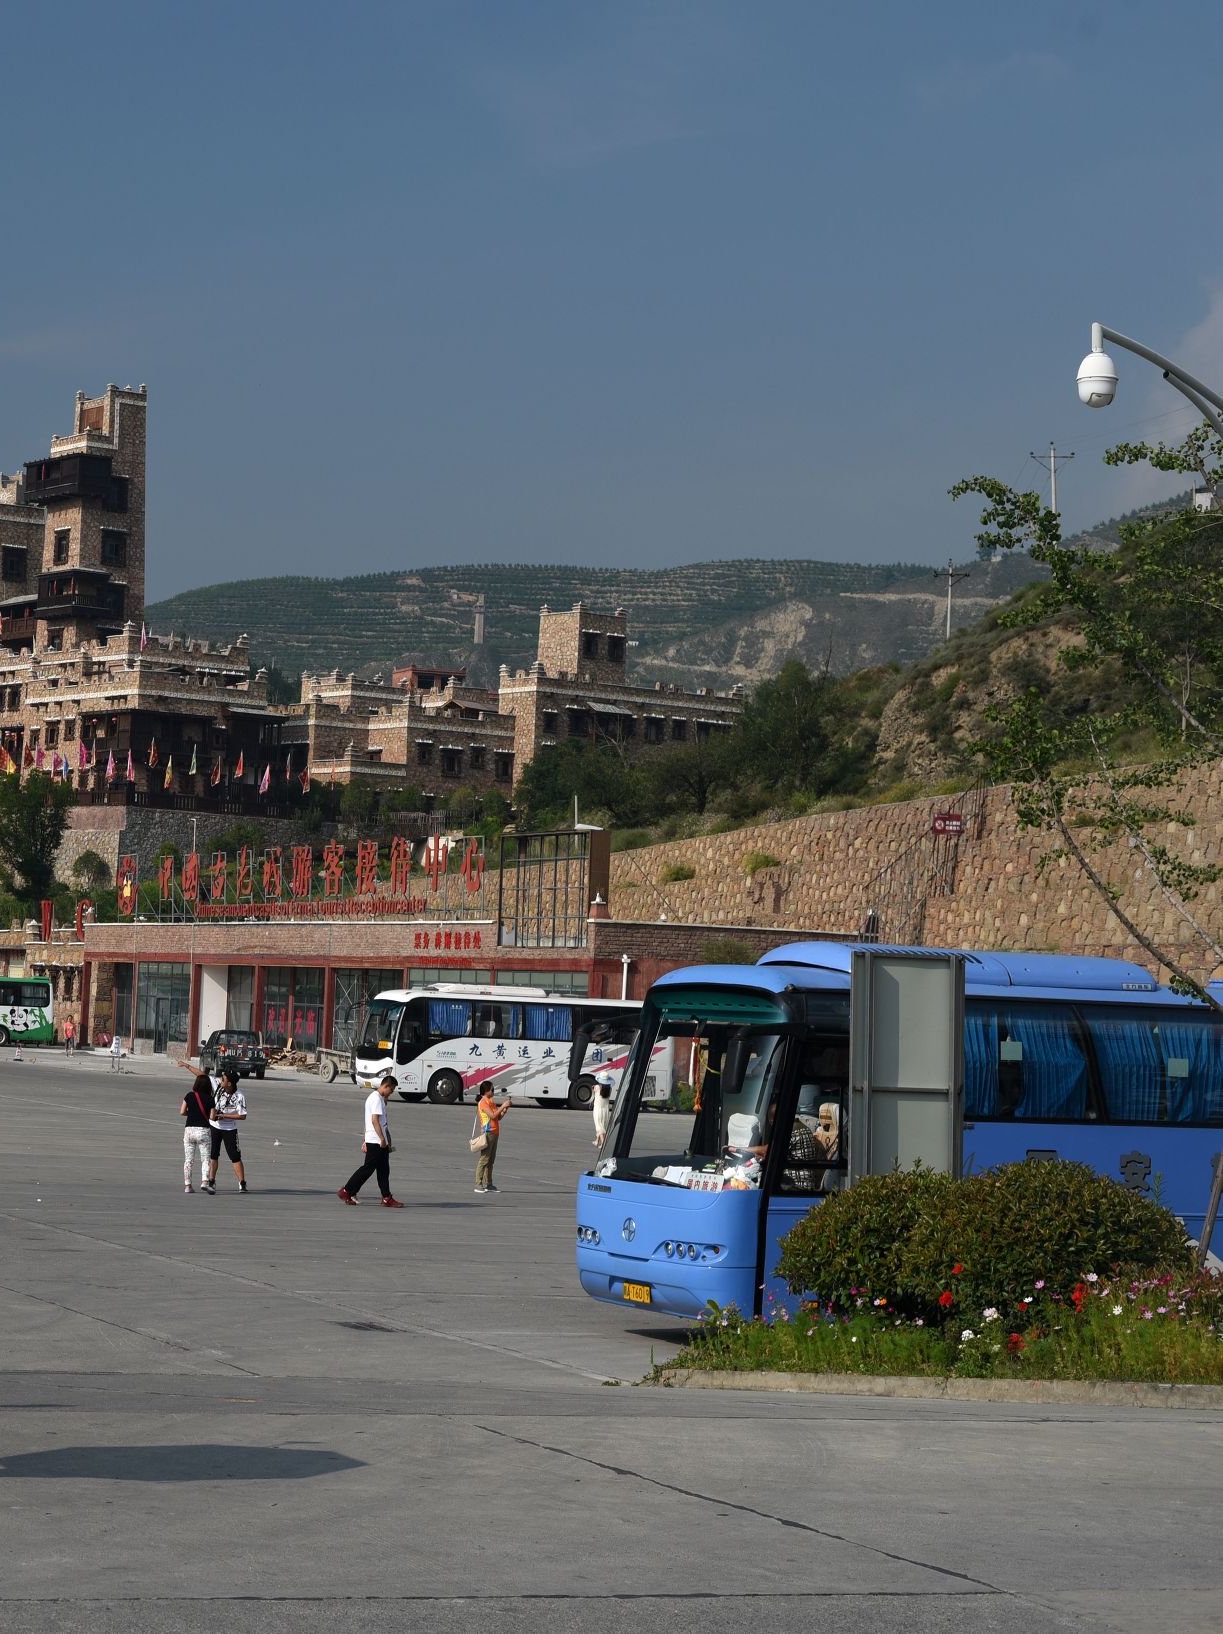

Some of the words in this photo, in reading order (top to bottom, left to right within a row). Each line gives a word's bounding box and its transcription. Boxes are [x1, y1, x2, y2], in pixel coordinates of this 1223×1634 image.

[469, 1043, 603, 1063] 九黄运业团
